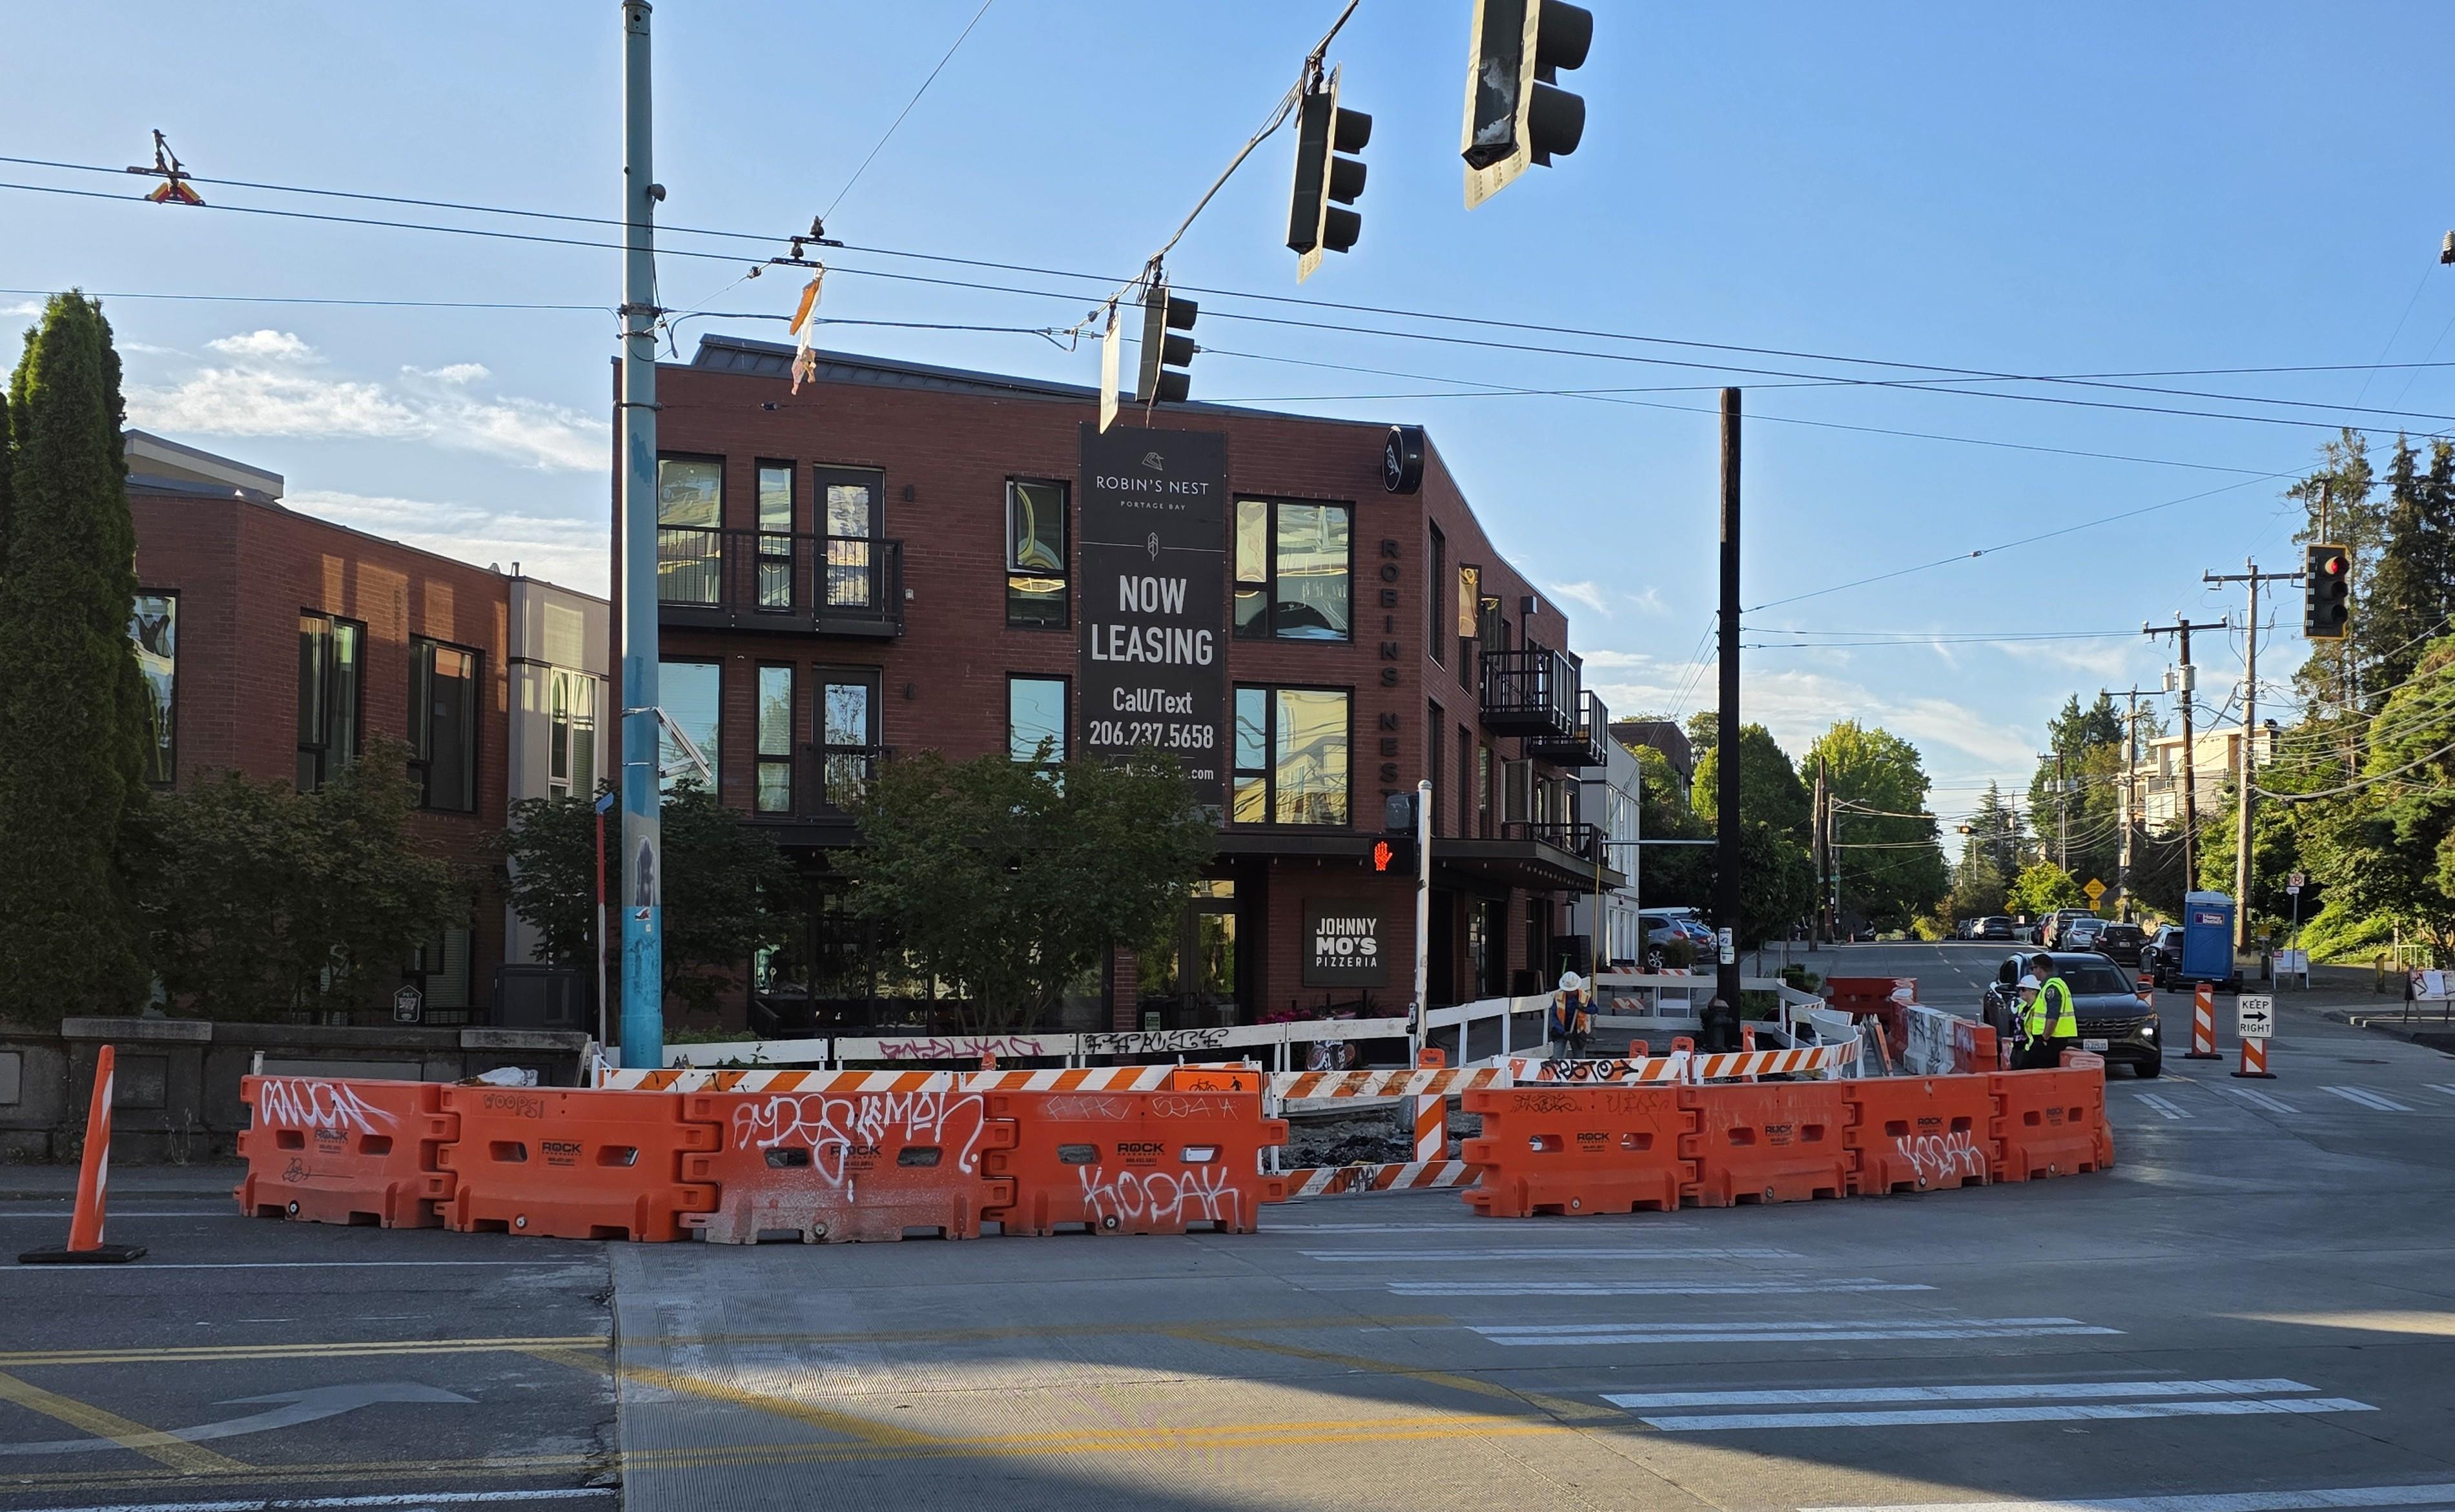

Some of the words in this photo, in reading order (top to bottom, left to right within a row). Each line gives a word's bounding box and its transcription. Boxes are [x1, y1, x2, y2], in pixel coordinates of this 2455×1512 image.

[1096, 476, 1163, 493] ROBIN'S
[1169, 481, 1209, 495] NEST
[1120, 500, 1164, 509] PORTAGE
[1120, 575, 1187, 614] NOW
[1381, 539, 1400, 688] ROBINS
[1091, 624, 1213, 666] LEASING
[1113, 687, 1193, 714] Call/Text
[1089, 720, 1214, 749] 206.237.5658
[1316, 918, 1377, 935] JOHNNY
[1316, 937, 1377, 955] MO'S
[1316, 957, 1377, 967] PIZZERIA
[2243, 1001, 2269, 1009] KEEP
[2240, 1024, 2270, 1032] RIGHT
[1917, 1117, 1943, 1126] ROCK
[314, 1129, 349, 1141] ROCK
[1577, 1132, 1610, 1141] ROCK
[542, 1141, 582, 1153] ROCK
[830, 1145, 882, 1156] ROCK
[1117, 1143, 1164, 1152] ROCK
[1079, 1165, 1240, 1227] KODAK
